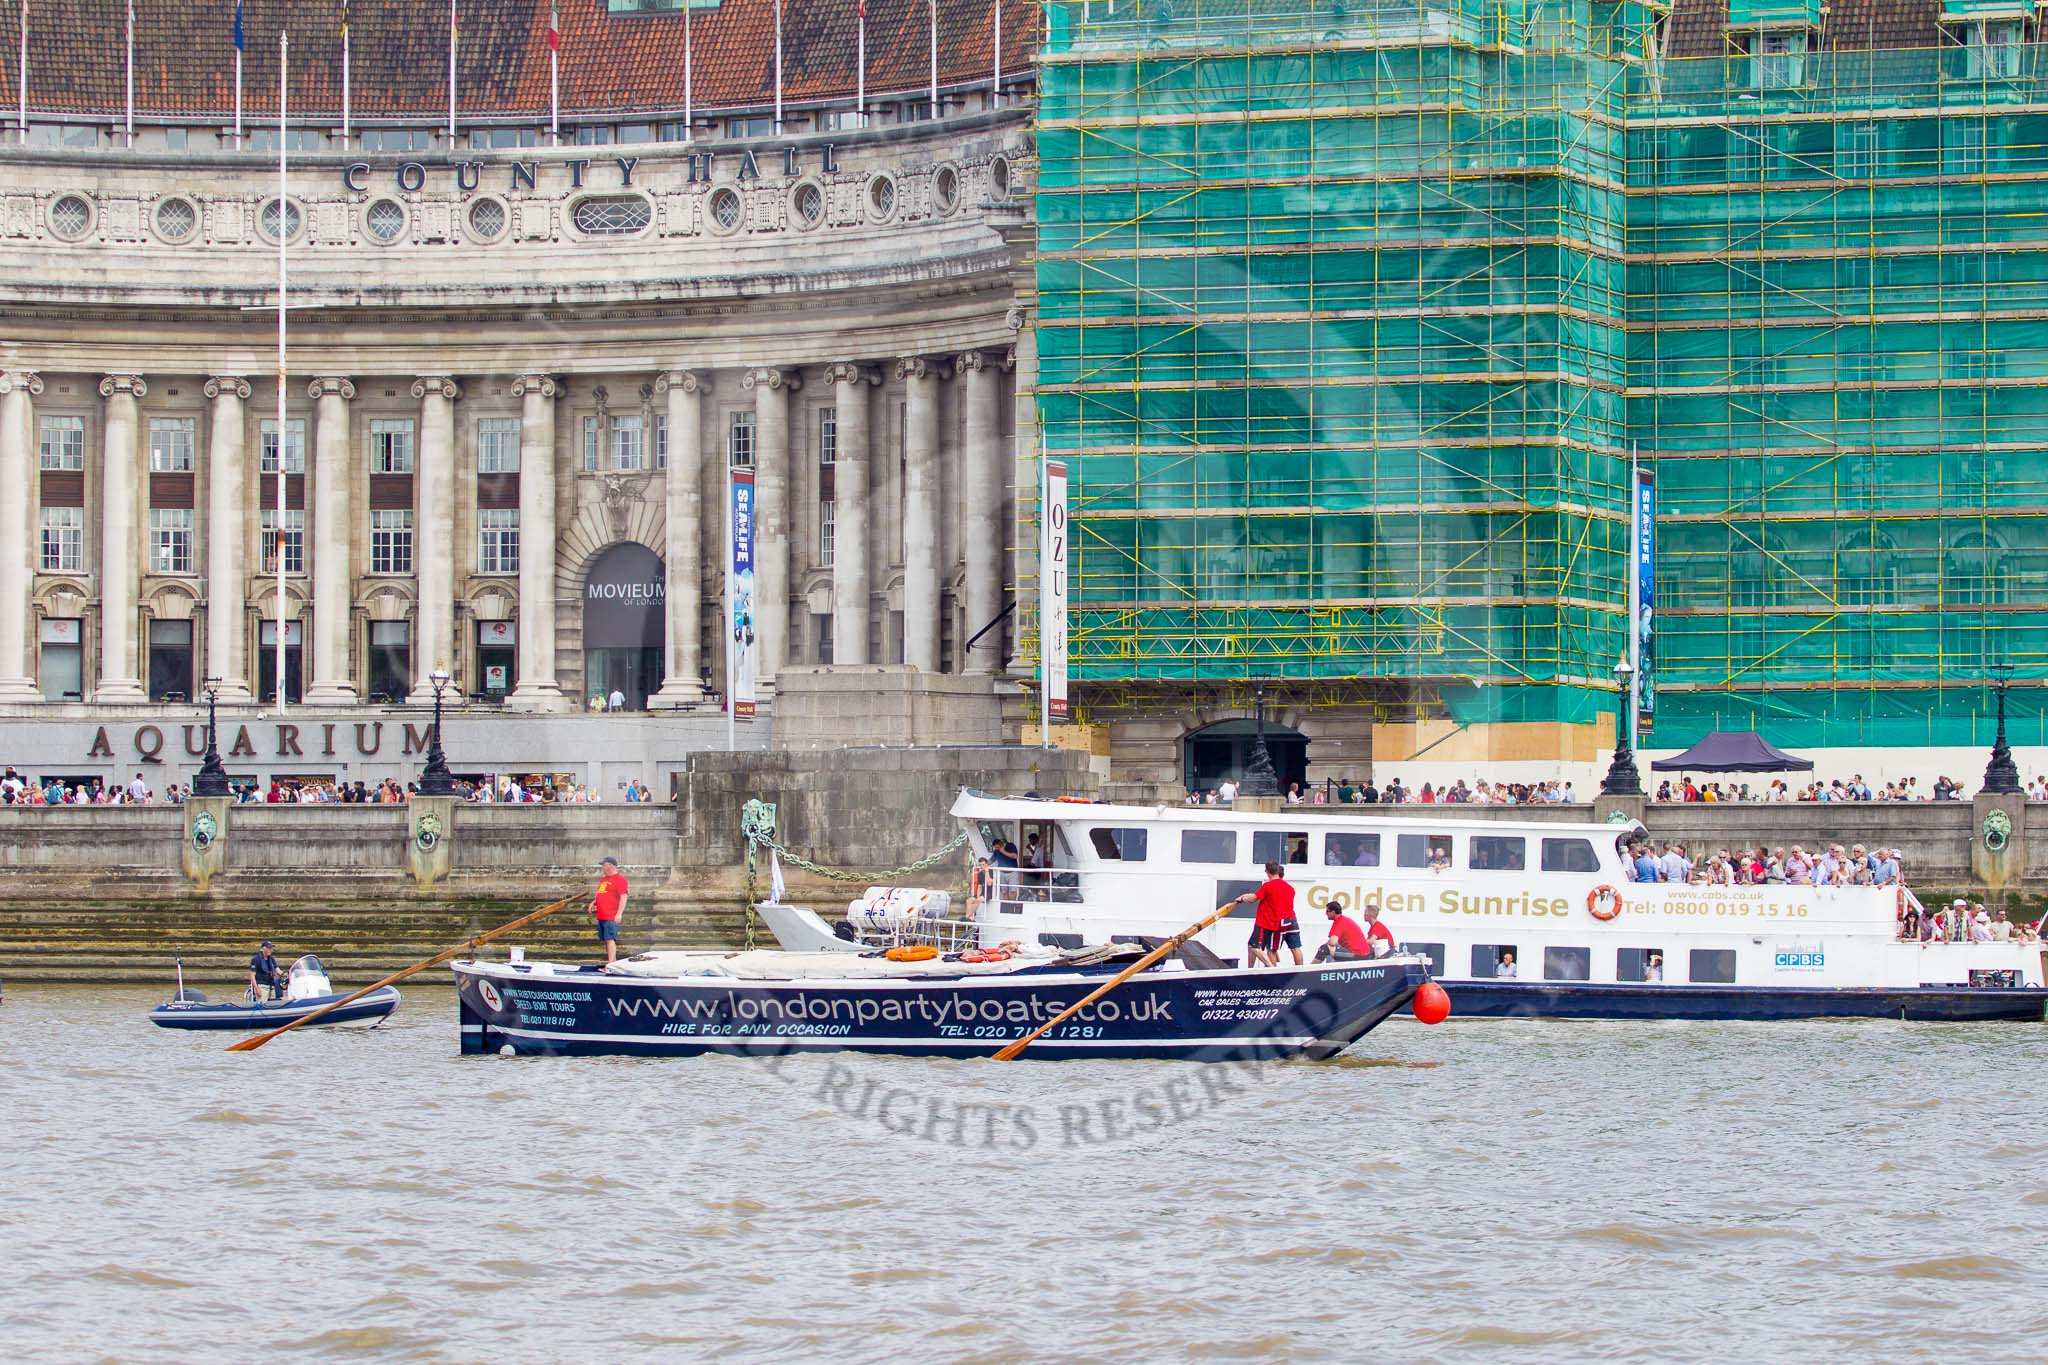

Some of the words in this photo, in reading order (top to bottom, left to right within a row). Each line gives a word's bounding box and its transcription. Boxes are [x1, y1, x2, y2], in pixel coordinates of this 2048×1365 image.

[343, 156, 639, 192] COUNTY
[687, 144, 840, 182] HALL
[738, 489, 749, 522] SEA
[736, 530, 748, 562] LIFE
[589, 584, 666, 598] MOVIEUM
[87, 723, 436, 763] AQUARIUM
[1307, 886, 1425, 912] Golden
[1440, 890, 1569, 917] Sunrise
[1668, 890, 1764, 900] www.cpbs.co.uk
[1624, 900, 1656, 914] Tel:
[1664, 902, 1708, 916] 0800
[1716, 903, 1749, 916] 019
[1757, 904, 1778, 916] 15
[1786, 904, 1808, 917] 16
[1776, 954, 1823, 965] CPBS
[1320, 970, 1384, 984] BENJAMIN
[486, 986, 498, 1004] 4
[1194, 988, 1307, 998] WWW.WRHCARSALES.CO.UK
[550, 1002, 576, 1012] TOURS
[608, 990, 1173, 1027] www.londonpartyboats.co.uk
[1198, 998, 1214, 1006] CAR
[1202, 1010, 1234, 1020] 01322
[1236, 1009, 1278, 1020] 430817
[662, 1024, 696, 1034] HIRE
[702, 1024, 732, 1034] FOR
[738, 1024, 770, 1034] ANY
[776, 1024, 851, 1035] OCCASION
[940, 1026, 968, 1036] TEL:
[974, 1026, 1006, 1038] 020
[1060, 1027, 1104, 1038] 1281
